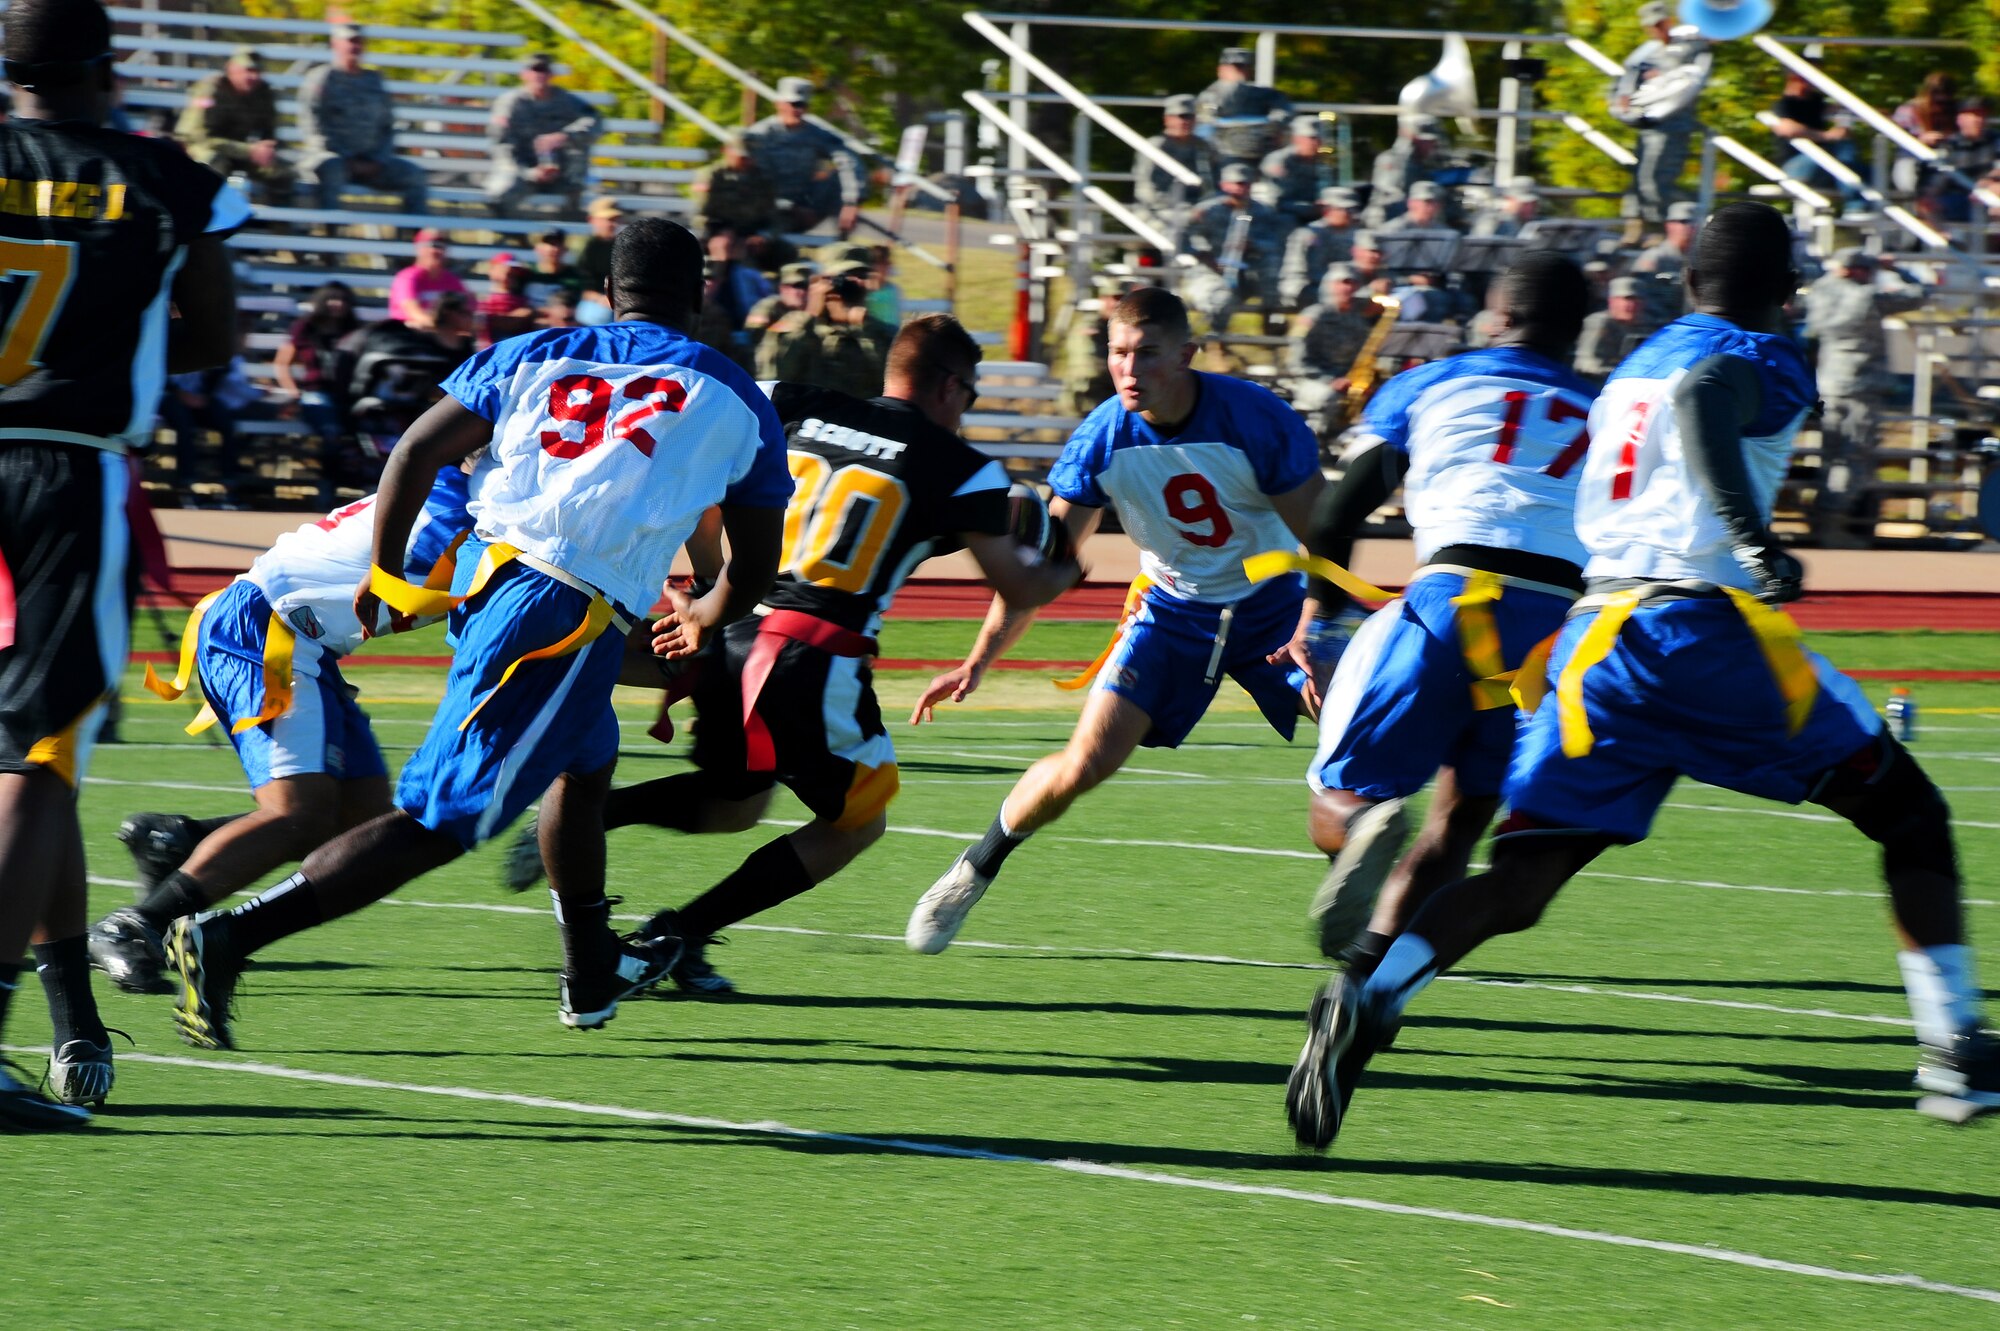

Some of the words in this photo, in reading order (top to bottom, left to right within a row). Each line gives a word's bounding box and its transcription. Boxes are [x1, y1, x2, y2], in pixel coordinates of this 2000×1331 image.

[541, 374, 688, 460] 92
[1492, 391, 1589, 480] 17
[1163, 472, 1234, 549] 9
